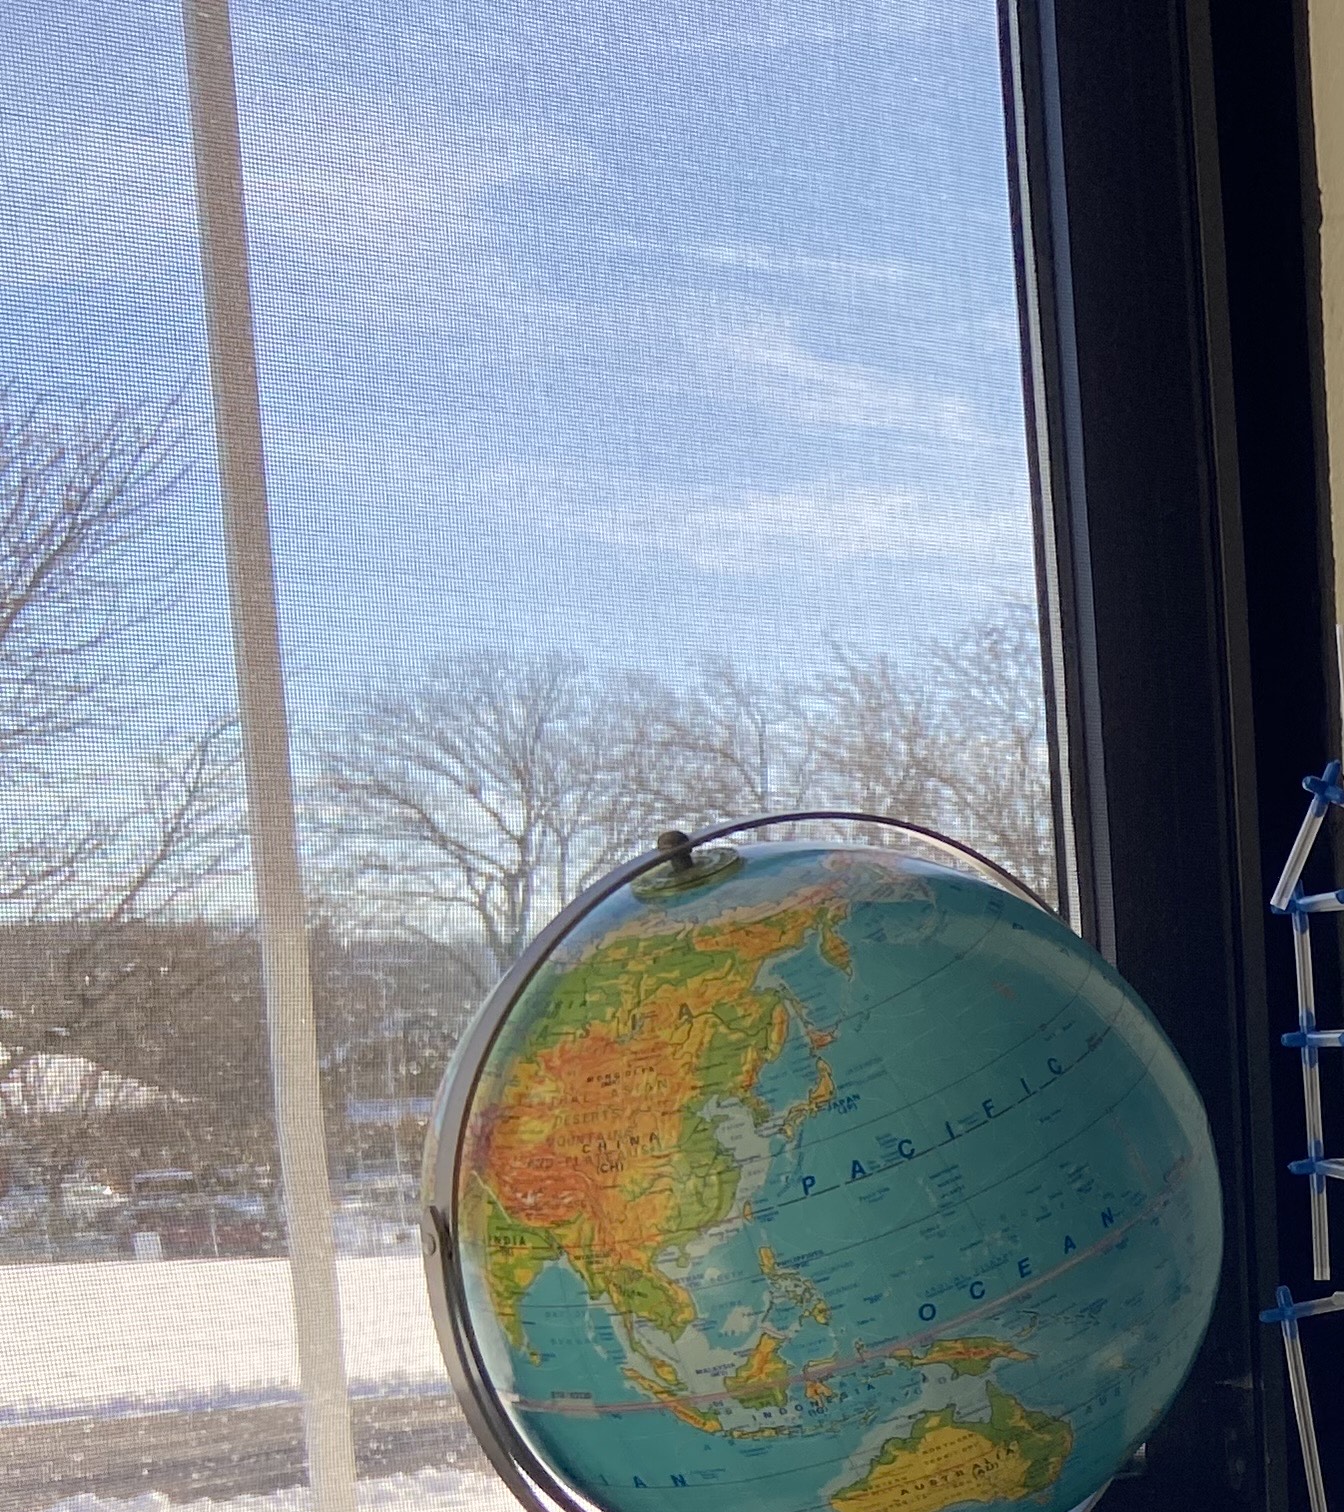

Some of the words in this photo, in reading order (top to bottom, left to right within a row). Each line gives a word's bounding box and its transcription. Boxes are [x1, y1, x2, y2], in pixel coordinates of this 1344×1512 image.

[827, 1094, 861, 1111] JAPAN
[582, 1131, 660, 1154] CHINA
[801, 1057, 1064, 1197] PACIFIC
[488, 1235, 526, 1246] INDIA
[918, 1207, 1115, 1322] OCEAN
[900, 1447, 1015, 1496] AUSTRALIA
